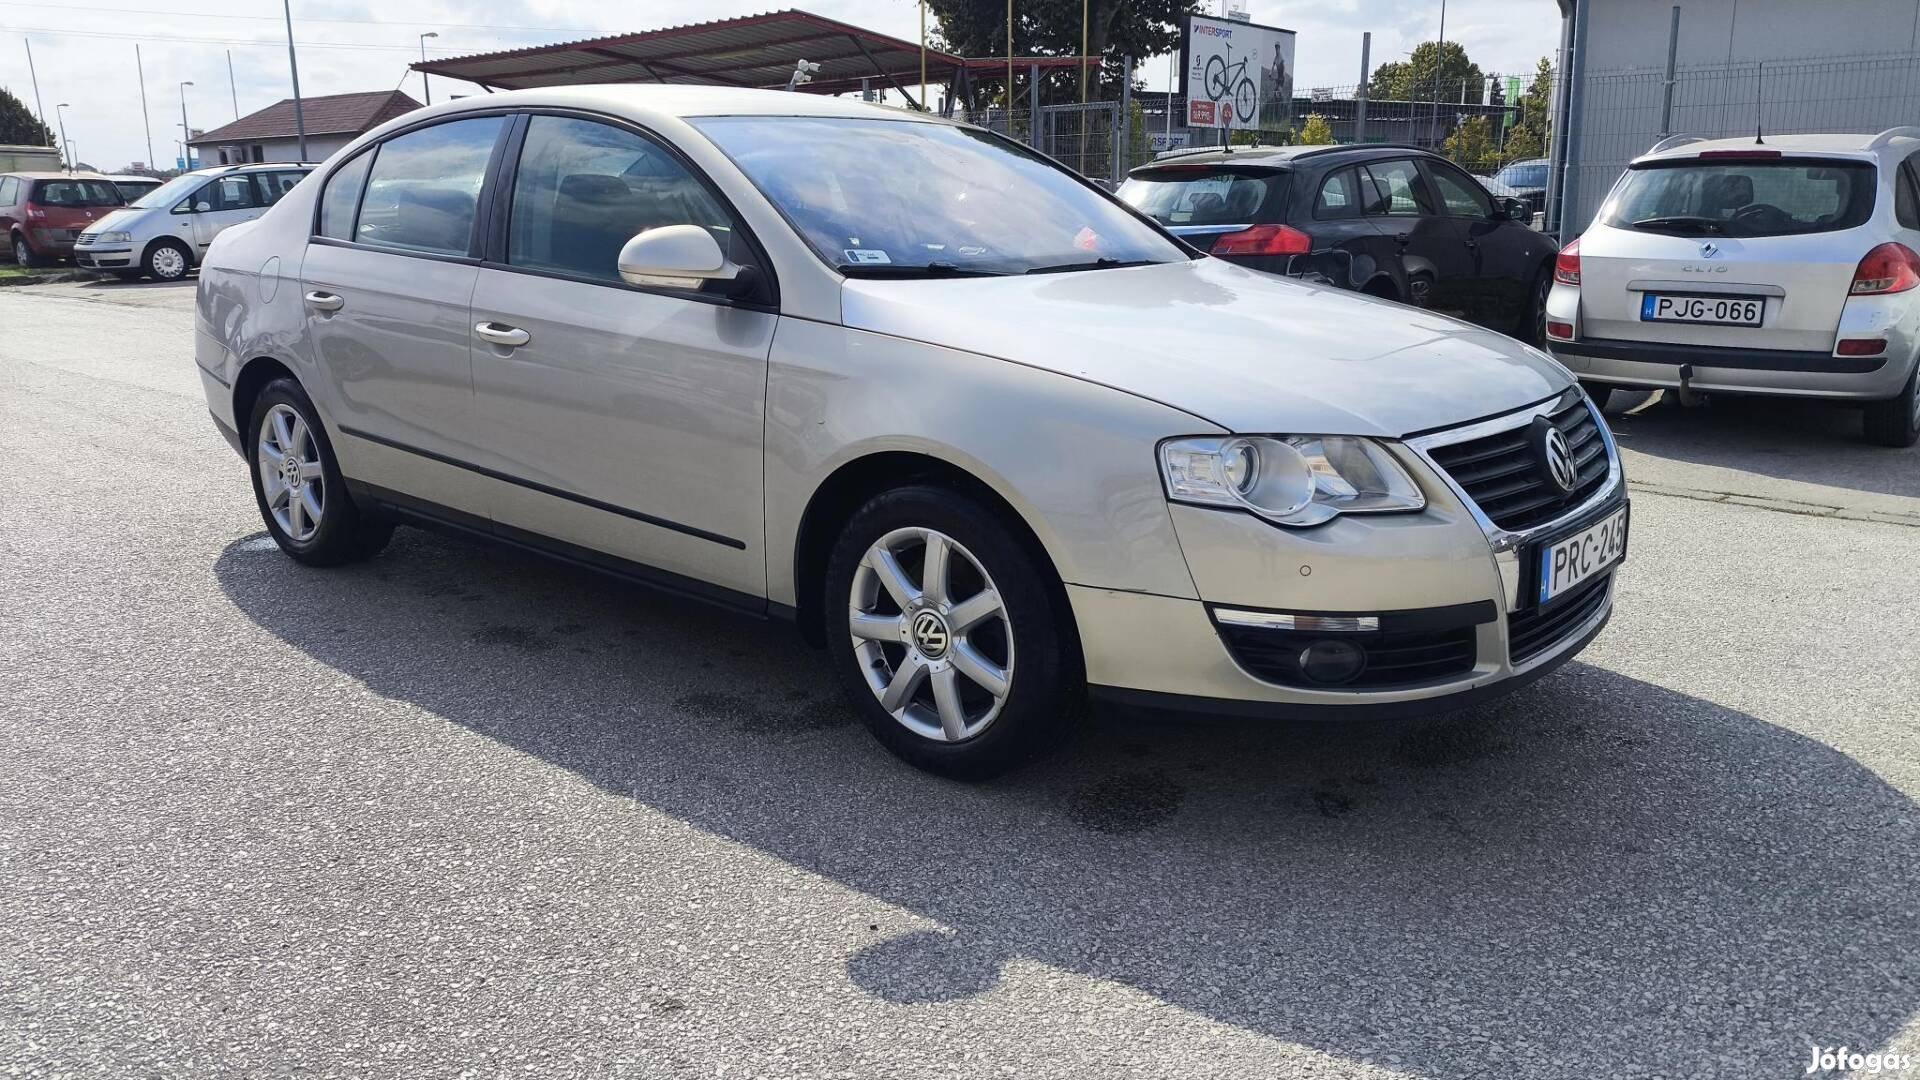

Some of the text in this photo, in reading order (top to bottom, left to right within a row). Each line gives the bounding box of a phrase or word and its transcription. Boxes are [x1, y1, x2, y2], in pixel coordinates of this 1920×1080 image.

[1681, 263, 1728, 273] CLIO
[1658, 298, 1757, 321] PJG-066
[1553, 513, 1624, 591] PRC-245
